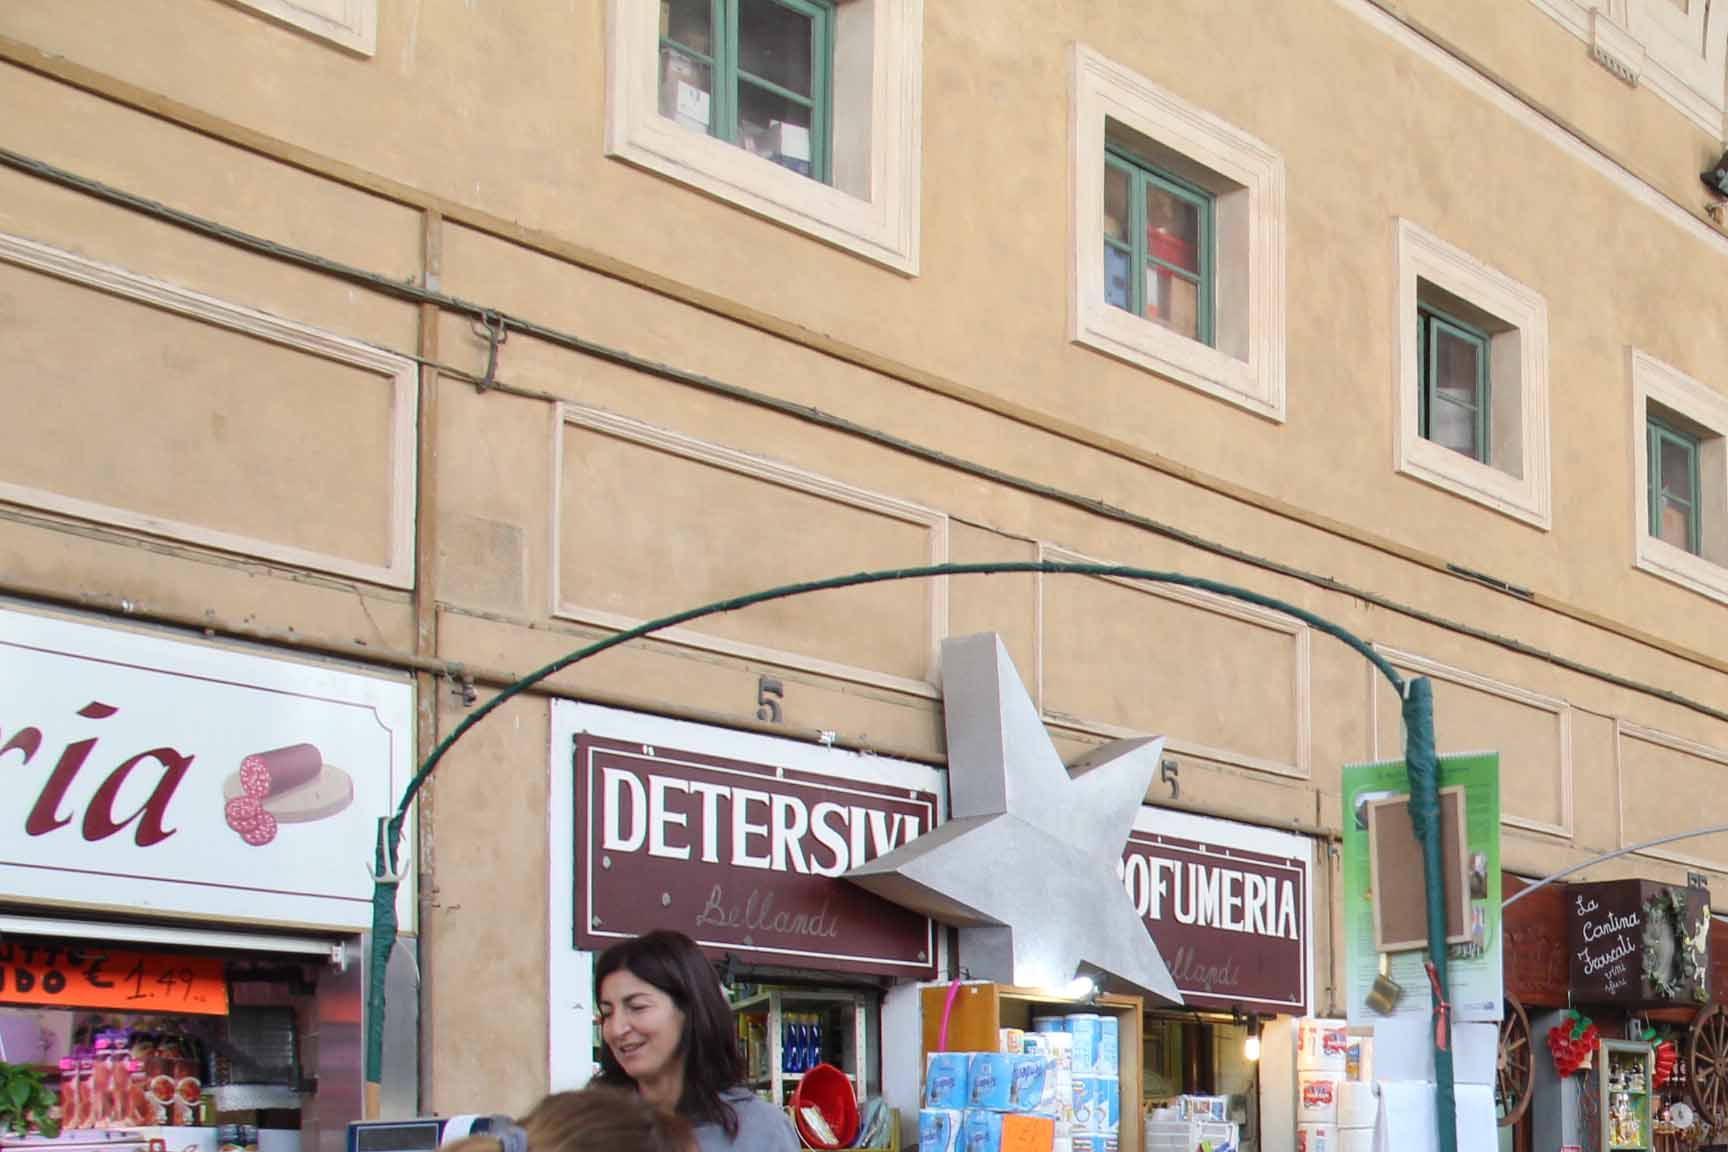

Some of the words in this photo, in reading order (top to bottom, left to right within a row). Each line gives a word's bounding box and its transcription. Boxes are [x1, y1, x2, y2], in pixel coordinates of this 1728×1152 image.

[1116, 854, 1298, 940] OFUMERIA
[1576, 895, 1598, 916] La
[1583, 911, 1640, 942] Cantina
[1168, 945, 1241, 986] llandi
